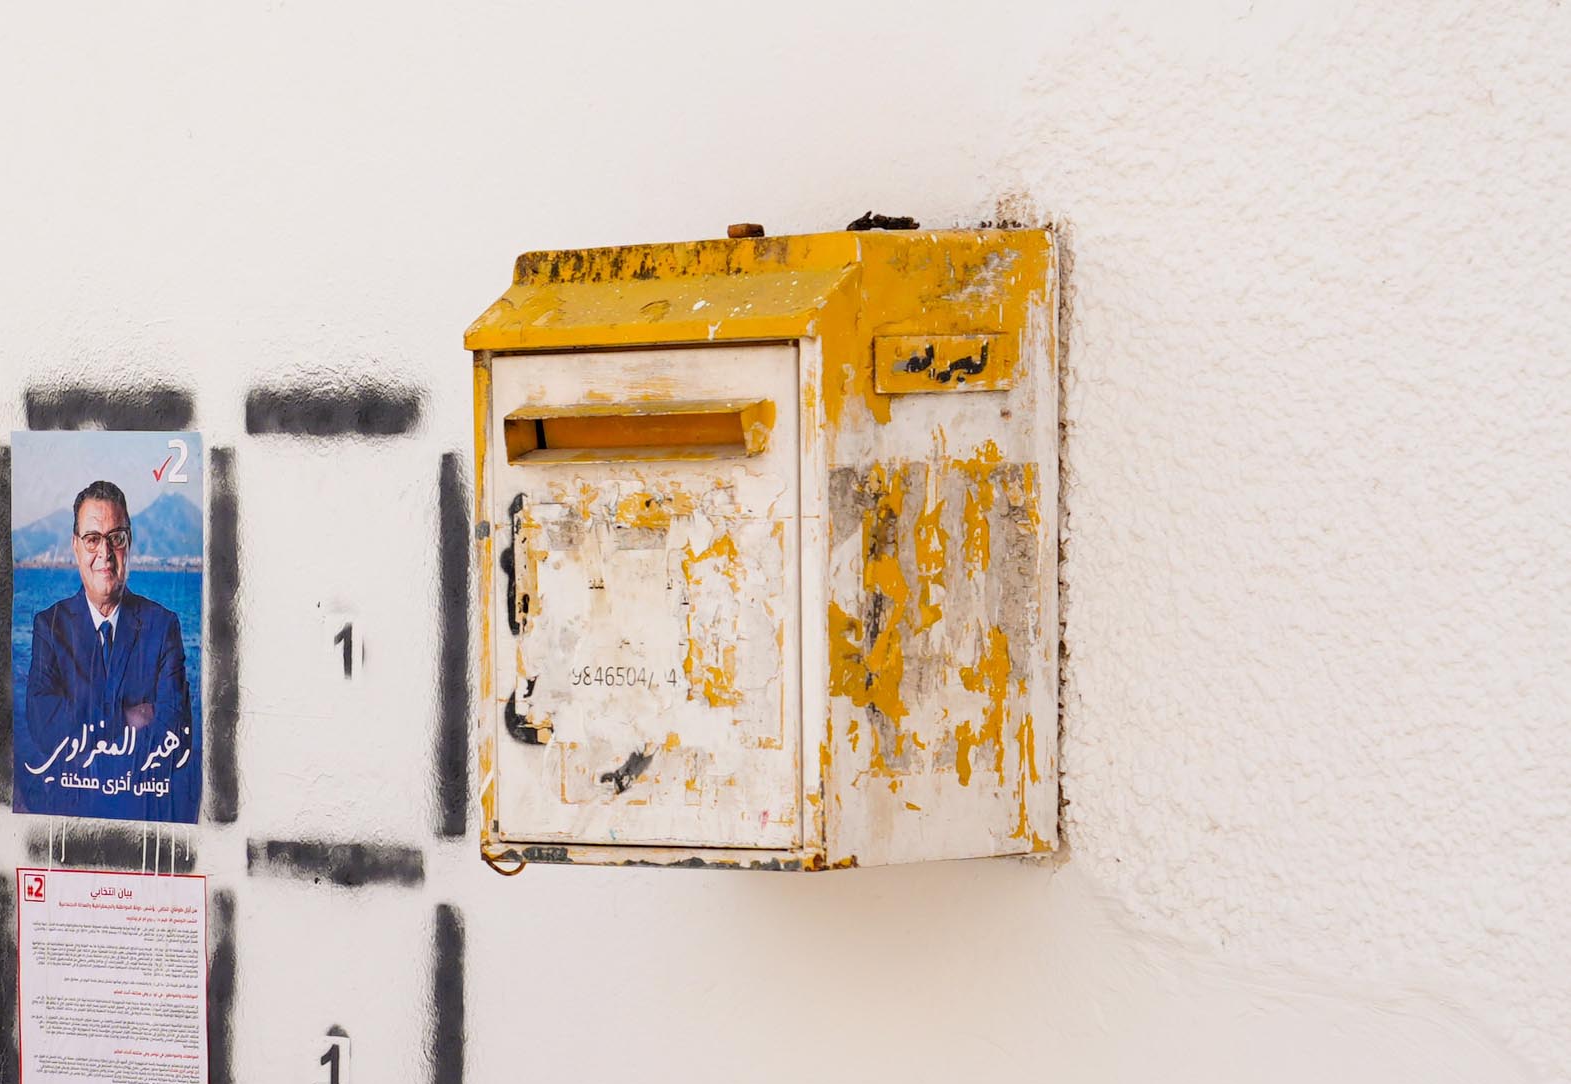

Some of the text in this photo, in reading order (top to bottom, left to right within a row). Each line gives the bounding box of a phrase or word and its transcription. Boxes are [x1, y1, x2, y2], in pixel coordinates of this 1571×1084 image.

[167, 437, 189, 484] 2
[333, 621, 353, 680] 1
[24, 720, 191, 784] زهير المغزاوي
[60, 771, 170, 797] تونس أخرى ممكنة
[90, 886, 133, 900] بيان انتخابي
